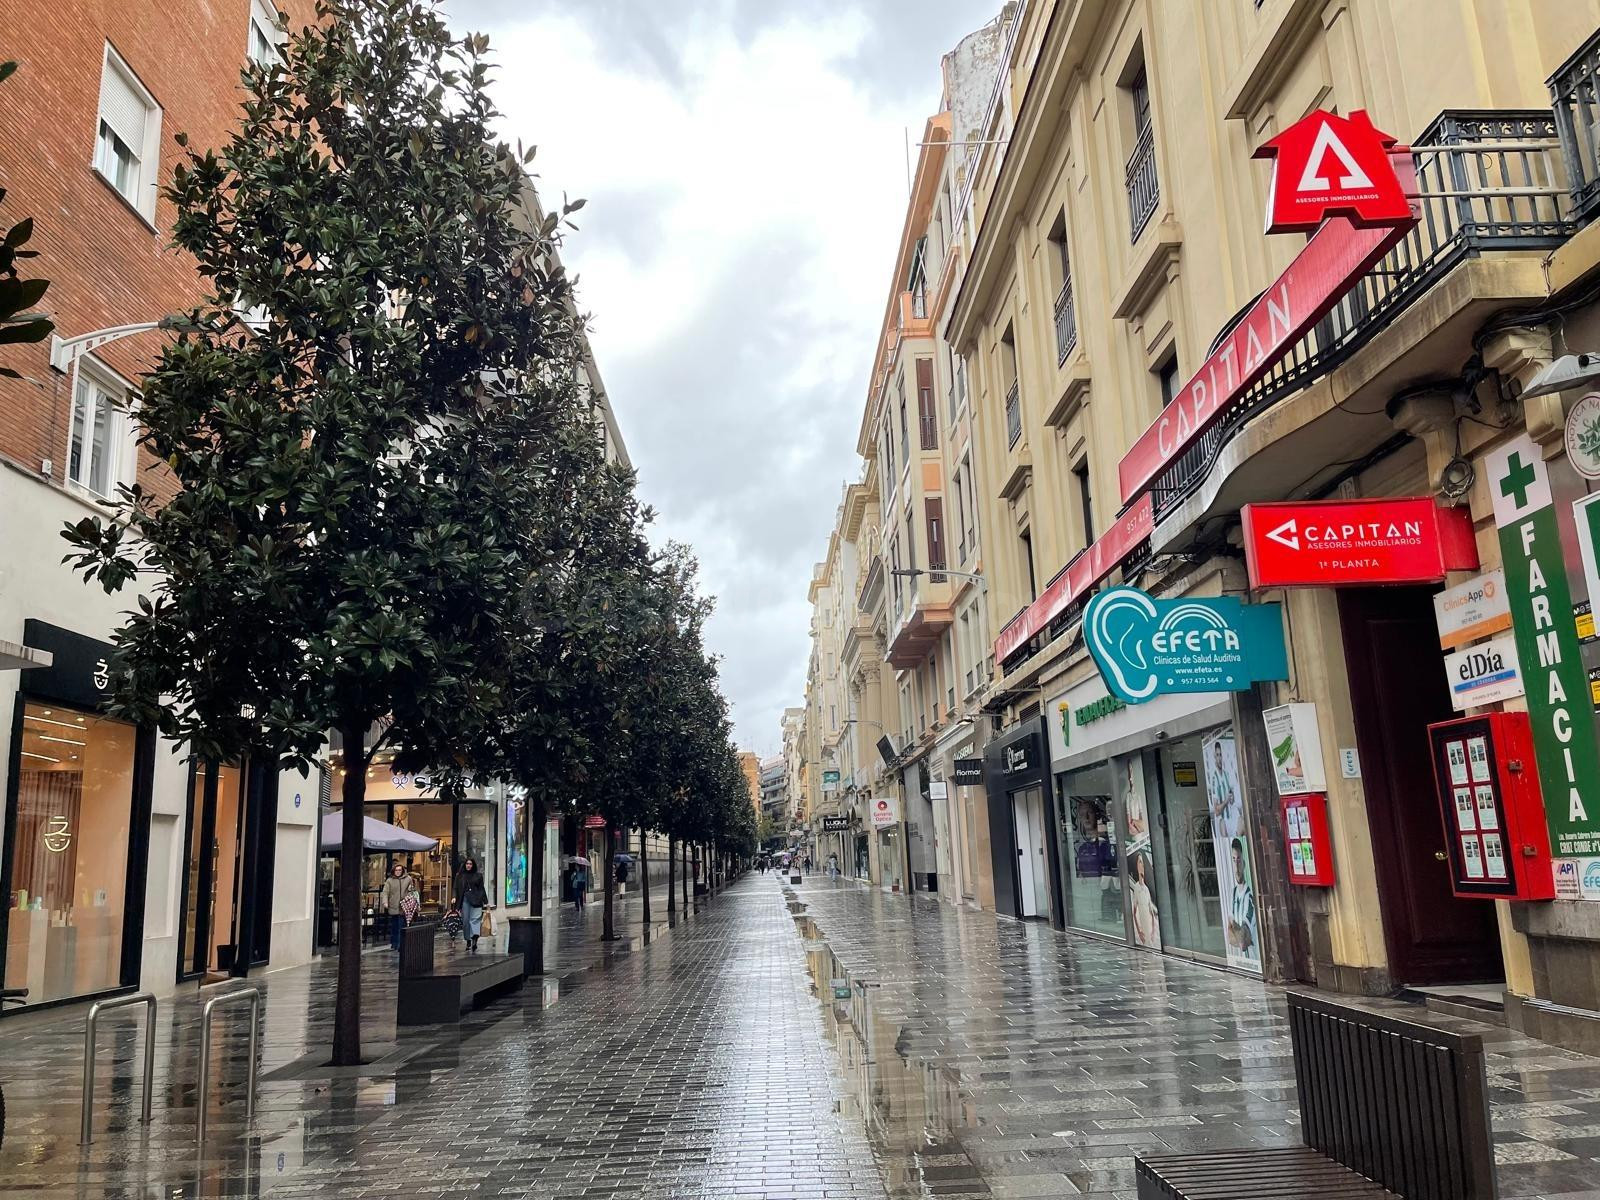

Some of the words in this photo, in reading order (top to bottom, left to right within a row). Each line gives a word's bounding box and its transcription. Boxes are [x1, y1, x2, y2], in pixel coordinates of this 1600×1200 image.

[1331, 194, 1379, 202] INMOBILIARIOS
[1158, 283, 1292, 458] CAPITAN
[1127, 520, 1138, 534] 957
[1304, 521, 1421, 541] CAPITAN
[1307, 541, 1353, 550] ASESORES
[1355, 537, 1422, 548] INMOBILIARIOS
[1332, 559, 1380, 569] PLANTA
[1443, 588, 1484, 612] ClinicsApp
[1151, 629, 1240, 653] EFETA
[1182, 655, 1192, 664] de
[1193, 654, 1212, 663] Salud
[1213, 653, 1241, 663] Auditiva
[1174, 666, 1223, 675] www.efeta.es
[1521, 520, 1588, 822] FARMACIA
